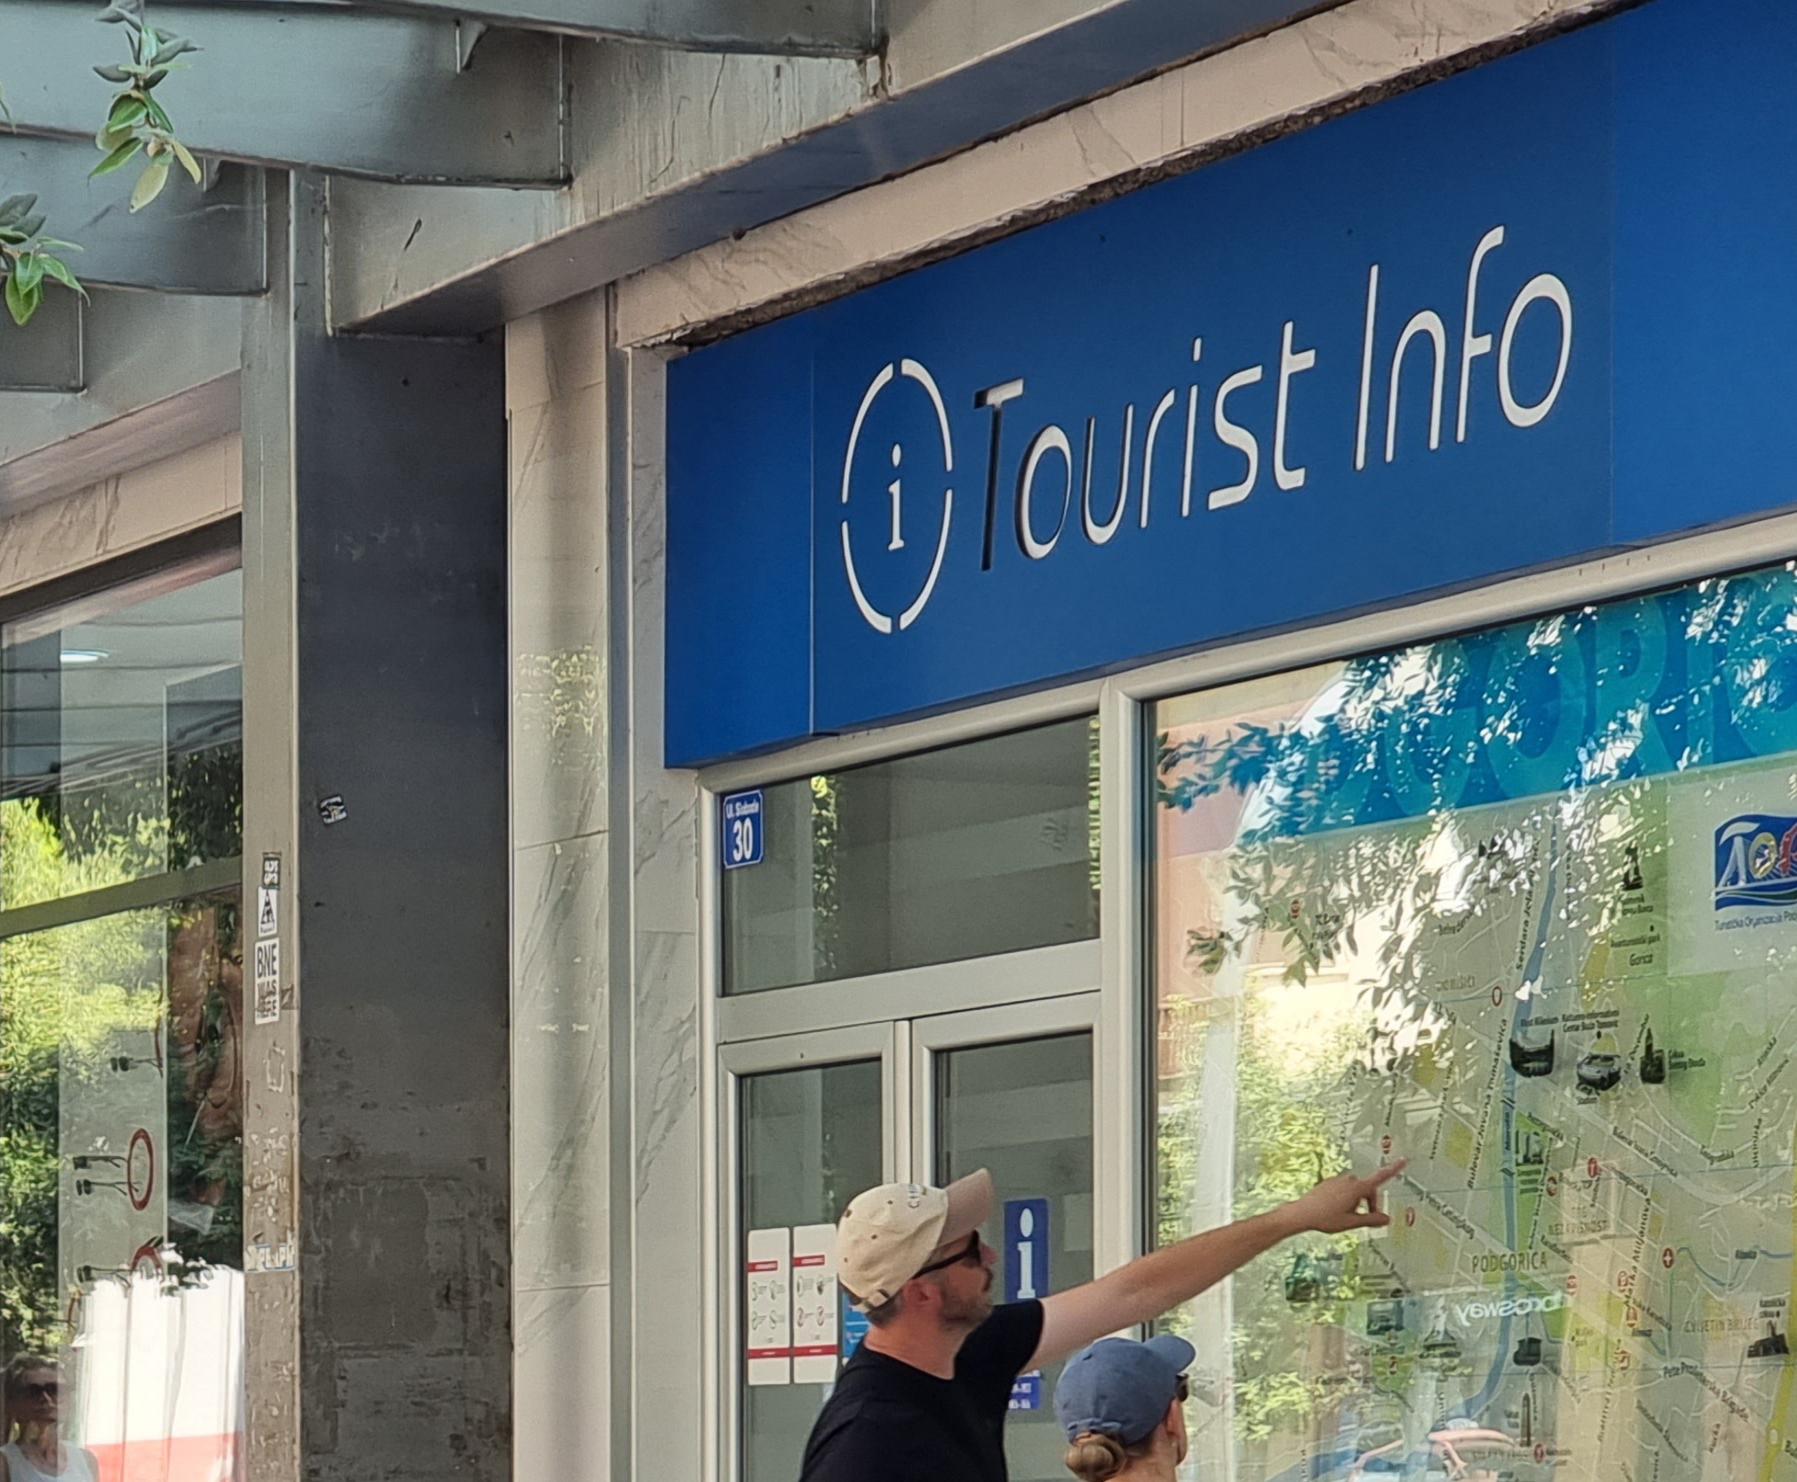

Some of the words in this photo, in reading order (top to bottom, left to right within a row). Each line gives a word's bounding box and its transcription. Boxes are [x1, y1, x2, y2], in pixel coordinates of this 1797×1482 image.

[975, 322, 1316, 571] Tourist
[1355, 225, 1574, 470] Info
[732, 817, 753, 862] 30
[257, 943, 278, 979] BNE
[1016, 1207, 1036, 1300] i
[1471, 1251, 1548, 1274] PODGORICA
